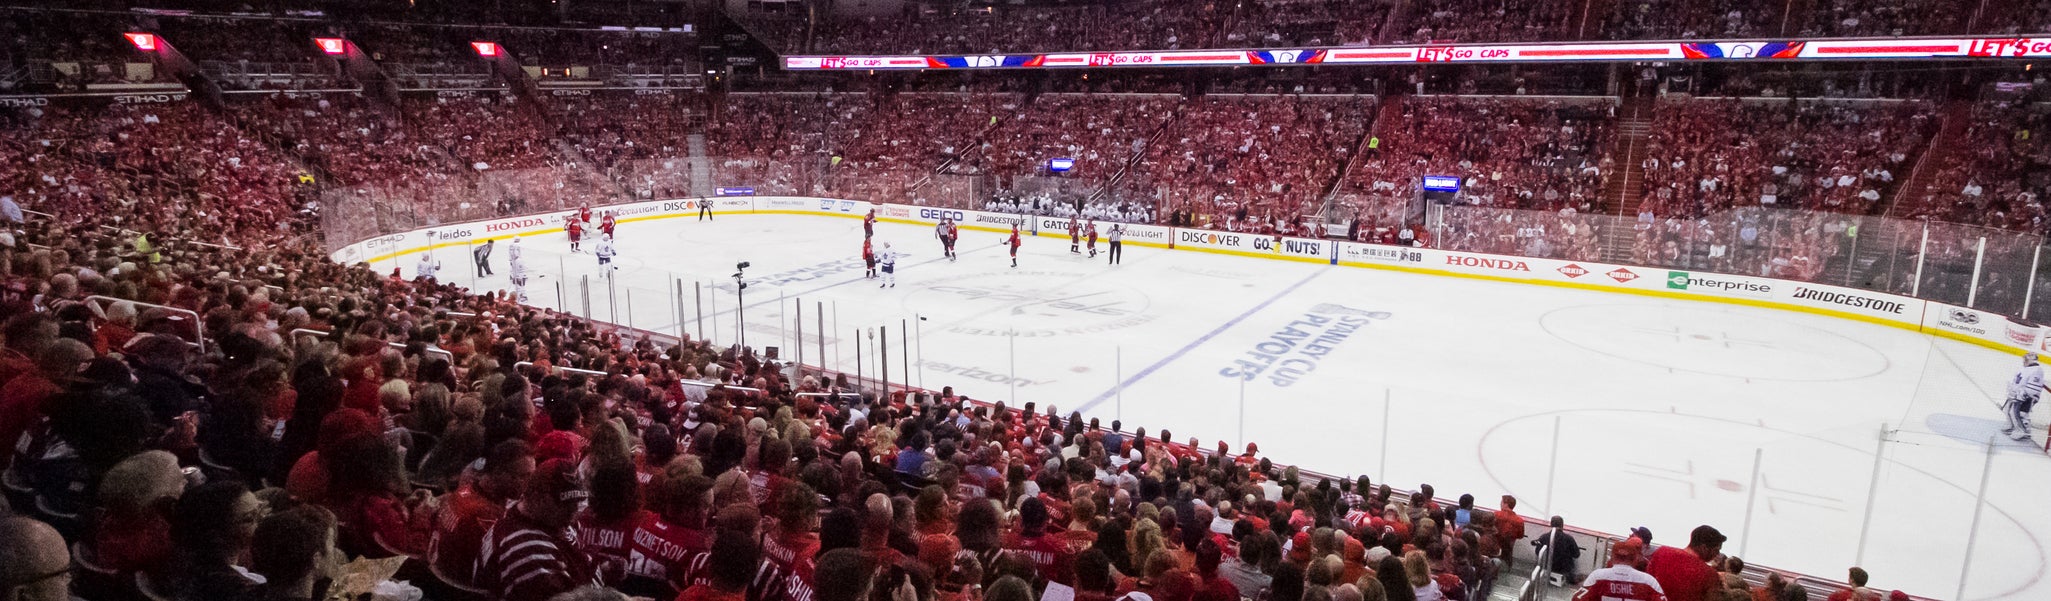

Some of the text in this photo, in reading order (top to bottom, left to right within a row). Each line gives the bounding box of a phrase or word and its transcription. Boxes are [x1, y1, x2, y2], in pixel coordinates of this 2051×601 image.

[1416, 46, 1510, 62] LET'S GO CAPS
[1968, 38, 2030, 58] LET'S
[820, 56, 847, 69] LET'S
[1088, 53, 1115, 67] LET'S
[1133, 55, 1153, 63] CAPS
[113, 94, 170, 104] ETIHAD
[920, 208, 963, 222] GEICO
[486, 217, 545, 233] HONDA
[366, 234, 406, 249] ETIHAD
[439, 228, 473, 241] leidos
[1181, 231, 1240, 247] DISCOVER
[1253, 237, 1321, 256] GO NUTS!
[1409, 251, 1422, 262] 88
[1445, 254, 1531, 273] HONDA
[1560, 267, 1585, 275] ORKIN
[1610, 271, 1635, 279] ORKIN
[1668, 276, 1771, 293] enterprise
[1793, 286, 1906, 315] BRIDGESTONE
[1299, 315, 1371, 361] STANLEY
[1218, 313, 1334, 382] PLAYOFFS
[1267, 358, 1317, 388] CUP
[632, 526, 688, 561] KUZNETSOV
[1609, 582, 1635, 596] OSHIE
